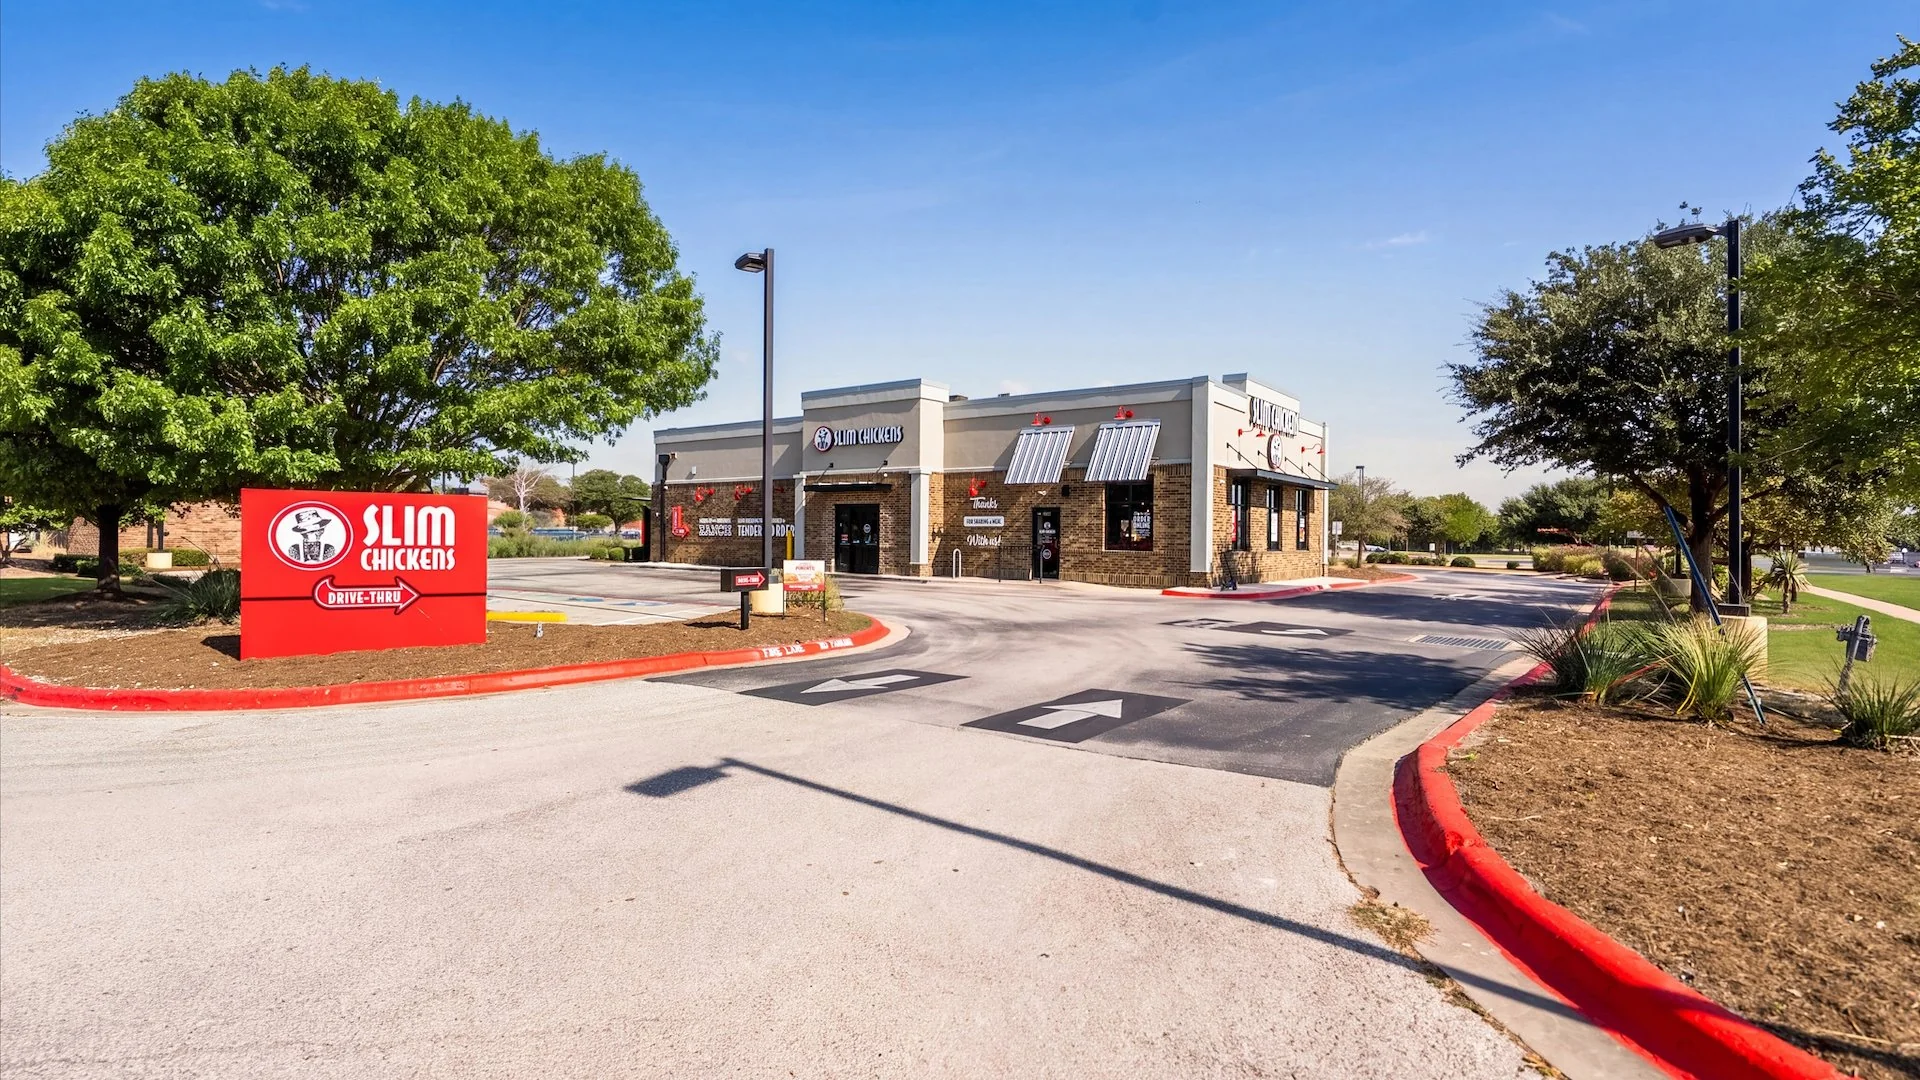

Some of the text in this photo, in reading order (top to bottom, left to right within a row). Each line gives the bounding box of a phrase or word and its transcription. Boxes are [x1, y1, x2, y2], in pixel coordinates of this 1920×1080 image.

[833, 426, 902, 446] SLIM CHICKENS
[969, 497, 998, 509] Thanks
[362, 504, 456, 547] SLIM
[737, 524, 763, 537] TENDER
[967, 534, 1002, 546] With us!
[360, 548, 456, 571] CHICKENS
[327, 590, 401, 605] DRIVE-THRU
